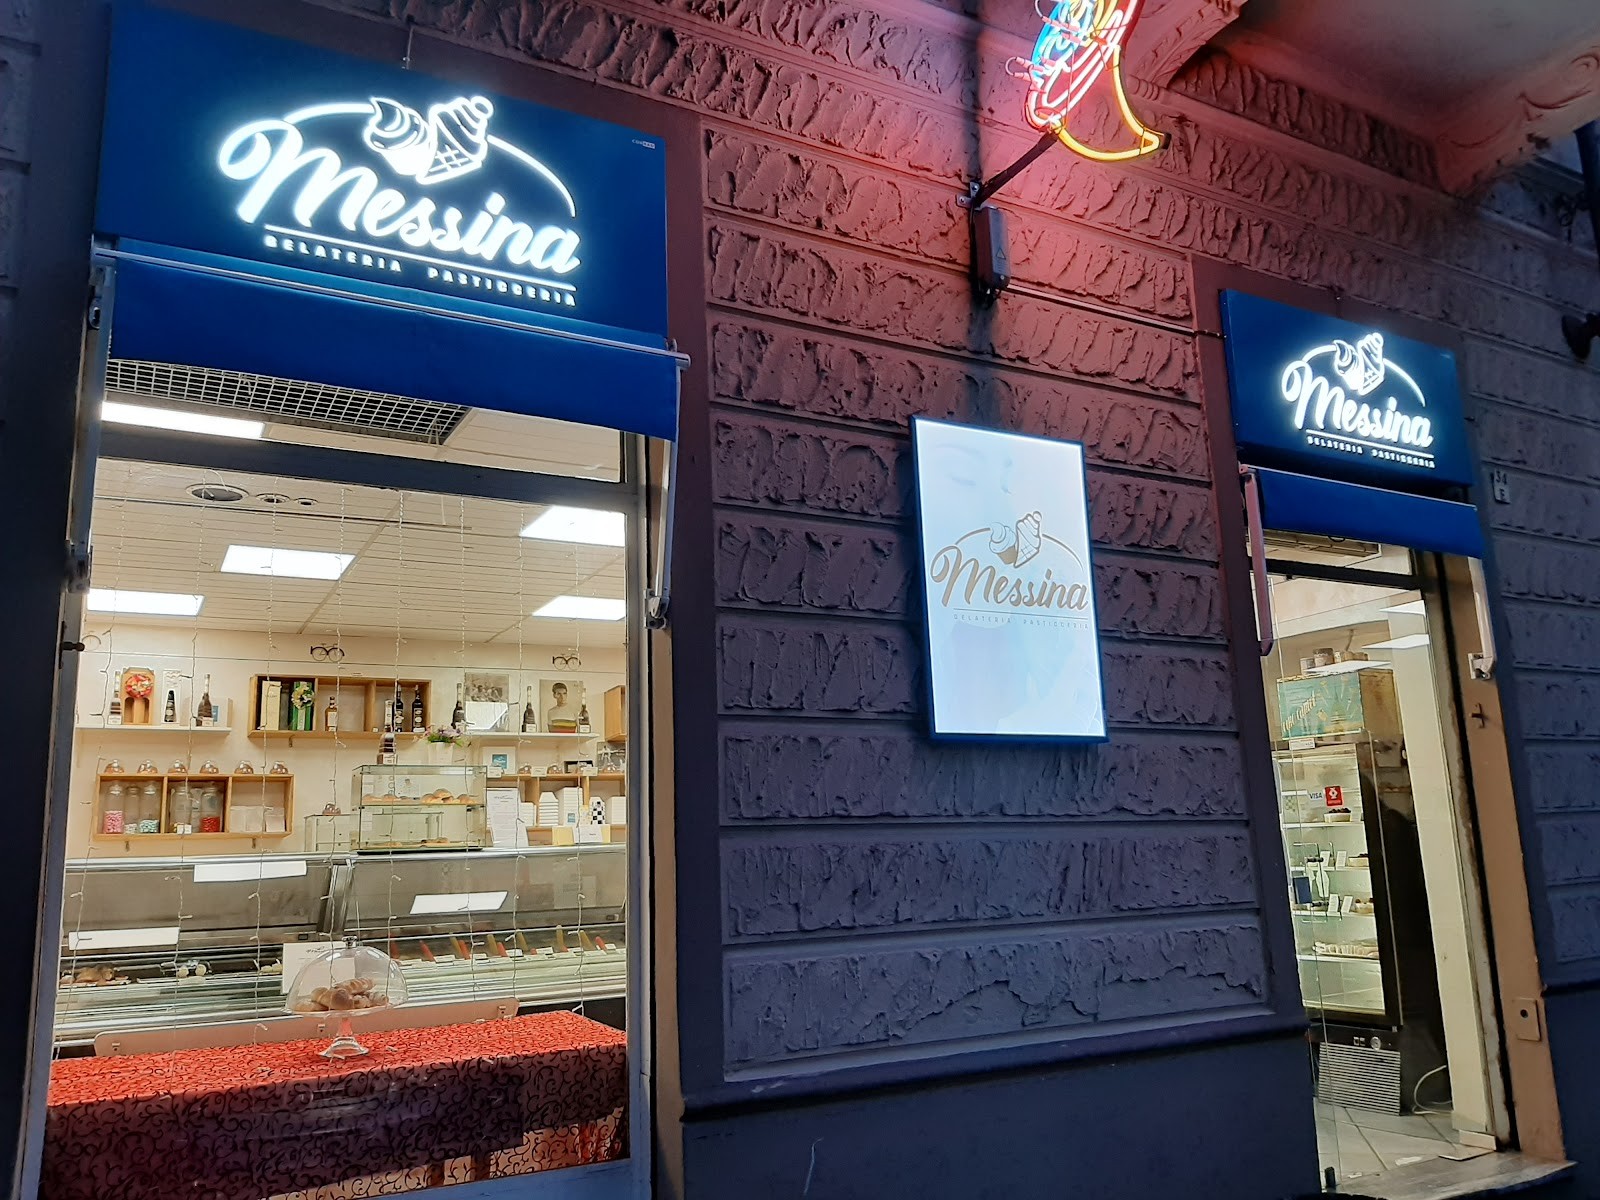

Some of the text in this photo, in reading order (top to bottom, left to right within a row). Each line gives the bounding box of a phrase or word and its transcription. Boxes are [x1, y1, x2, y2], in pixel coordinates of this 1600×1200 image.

[217, 119, 582, 275] Messina
[263, 233, 577, 308] GELATERIA PASTICCERIA
[1281, 360, 1434, 448] Messina
[930, 545, 1089, 611] Messina
[1309, 792, 1323, 800] VISA
